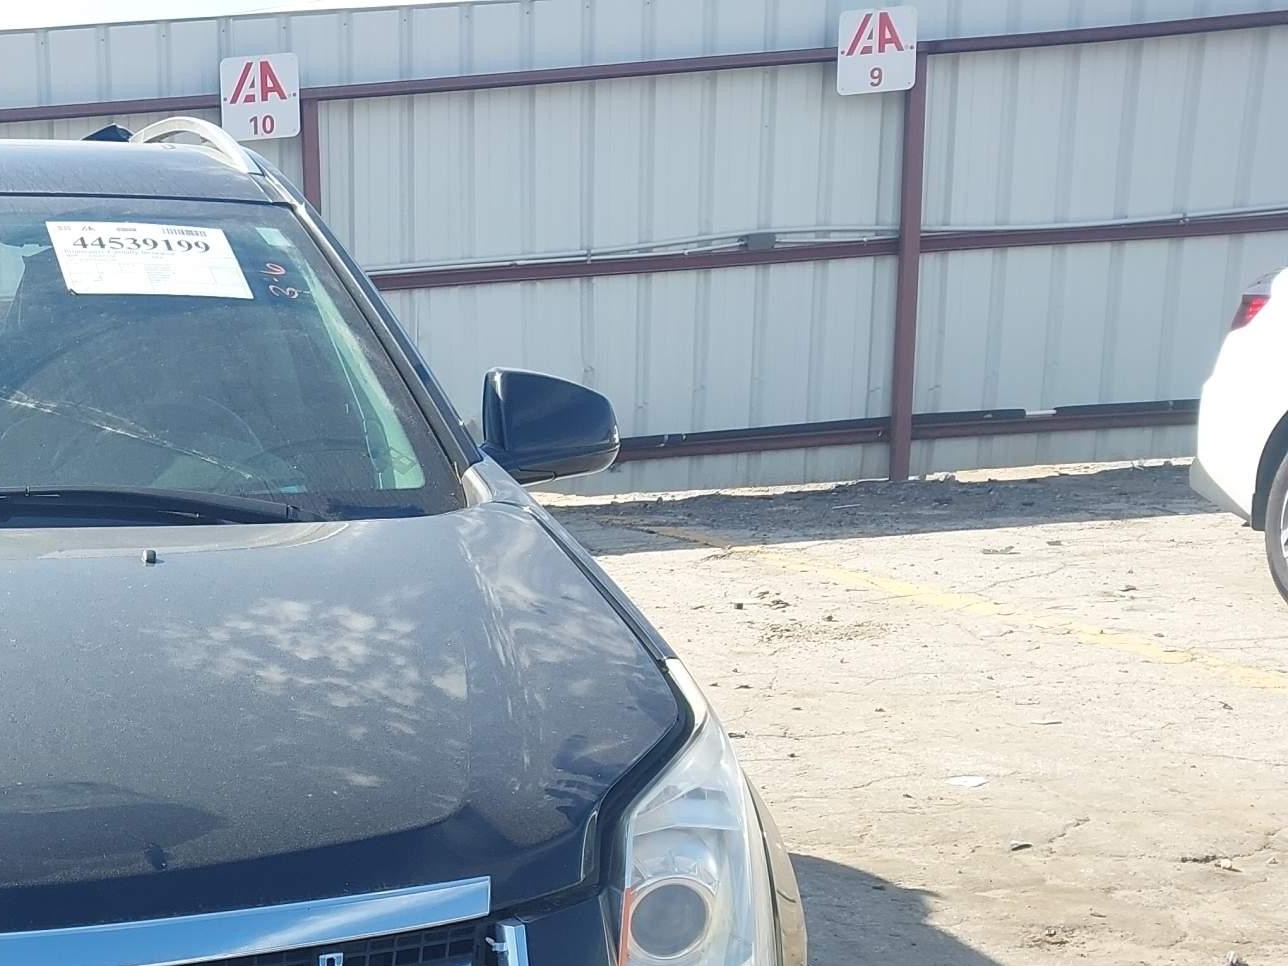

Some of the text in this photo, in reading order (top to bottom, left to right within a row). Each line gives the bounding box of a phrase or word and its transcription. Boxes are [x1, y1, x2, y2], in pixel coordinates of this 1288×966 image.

[869, 66, 883, 87] 9
[249, 115, 275, 135] 10
[72, 236, 211, 254] 44539199
